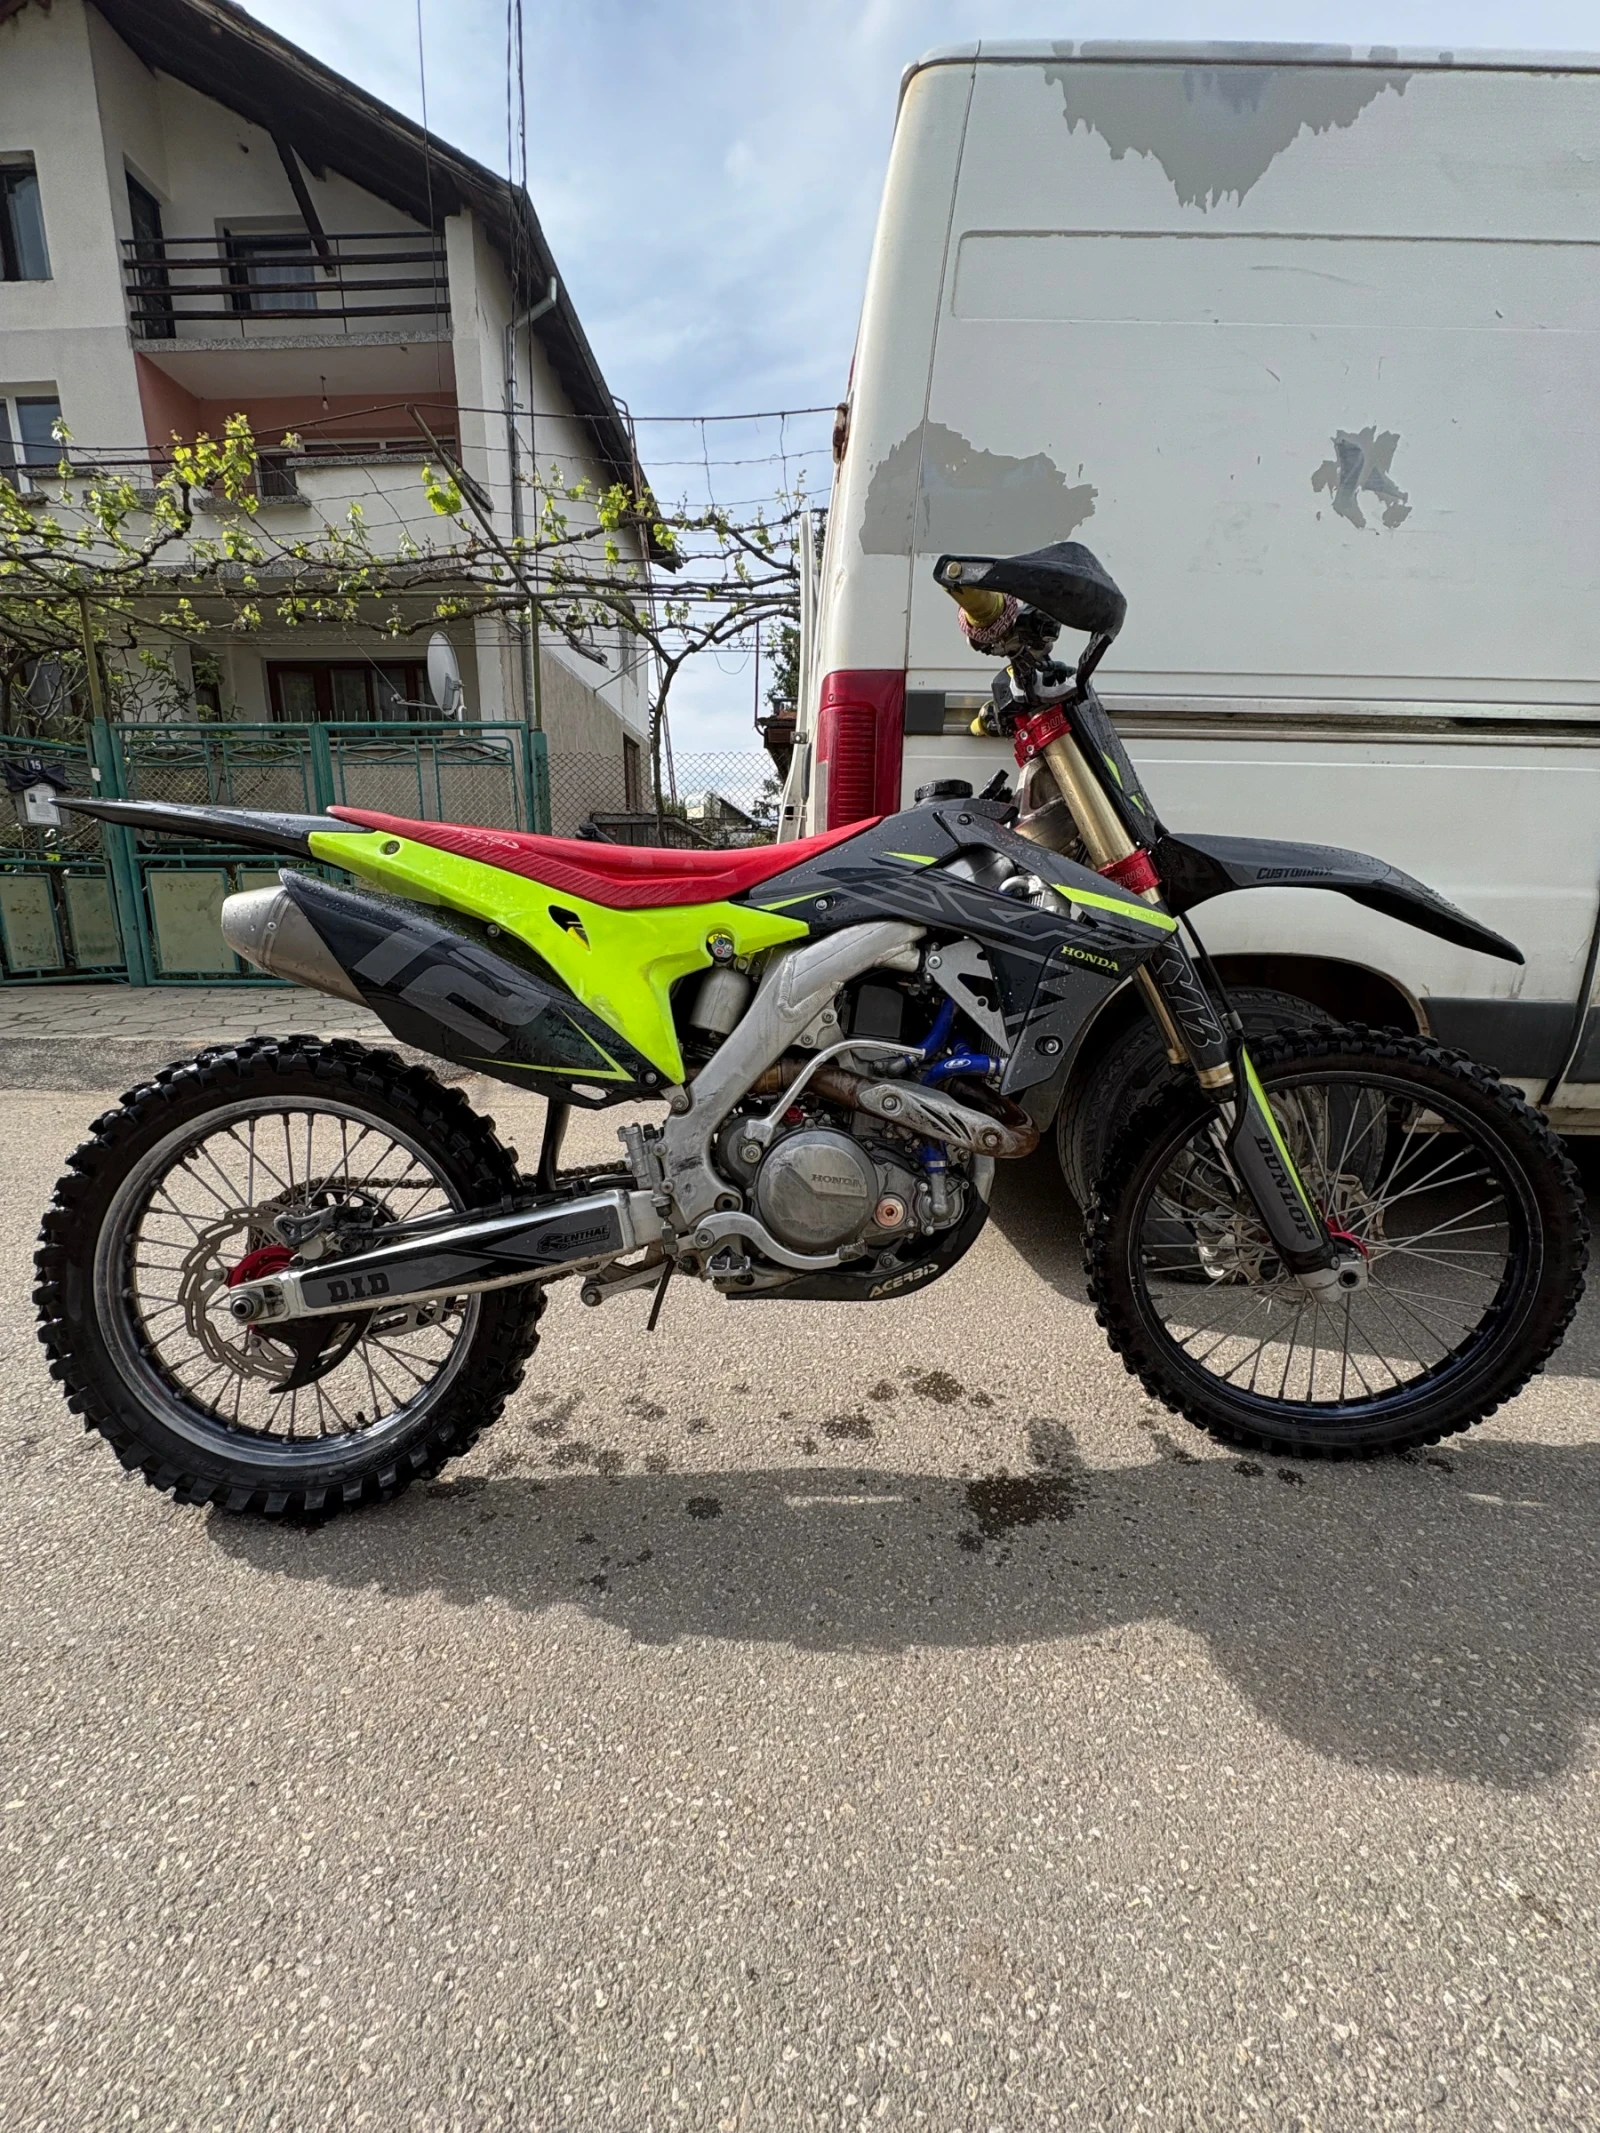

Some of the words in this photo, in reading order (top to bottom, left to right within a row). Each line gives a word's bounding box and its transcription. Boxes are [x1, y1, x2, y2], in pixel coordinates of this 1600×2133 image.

[30, 760, 42, 771] 15
[1061, 945, 1120, 972] HONDA
[811, 1173, 863, 1189] HONDA
[1253, 1135, 1316, 1241] DUNLOP
[537, 1225, 610, 1254] RENTHAL
